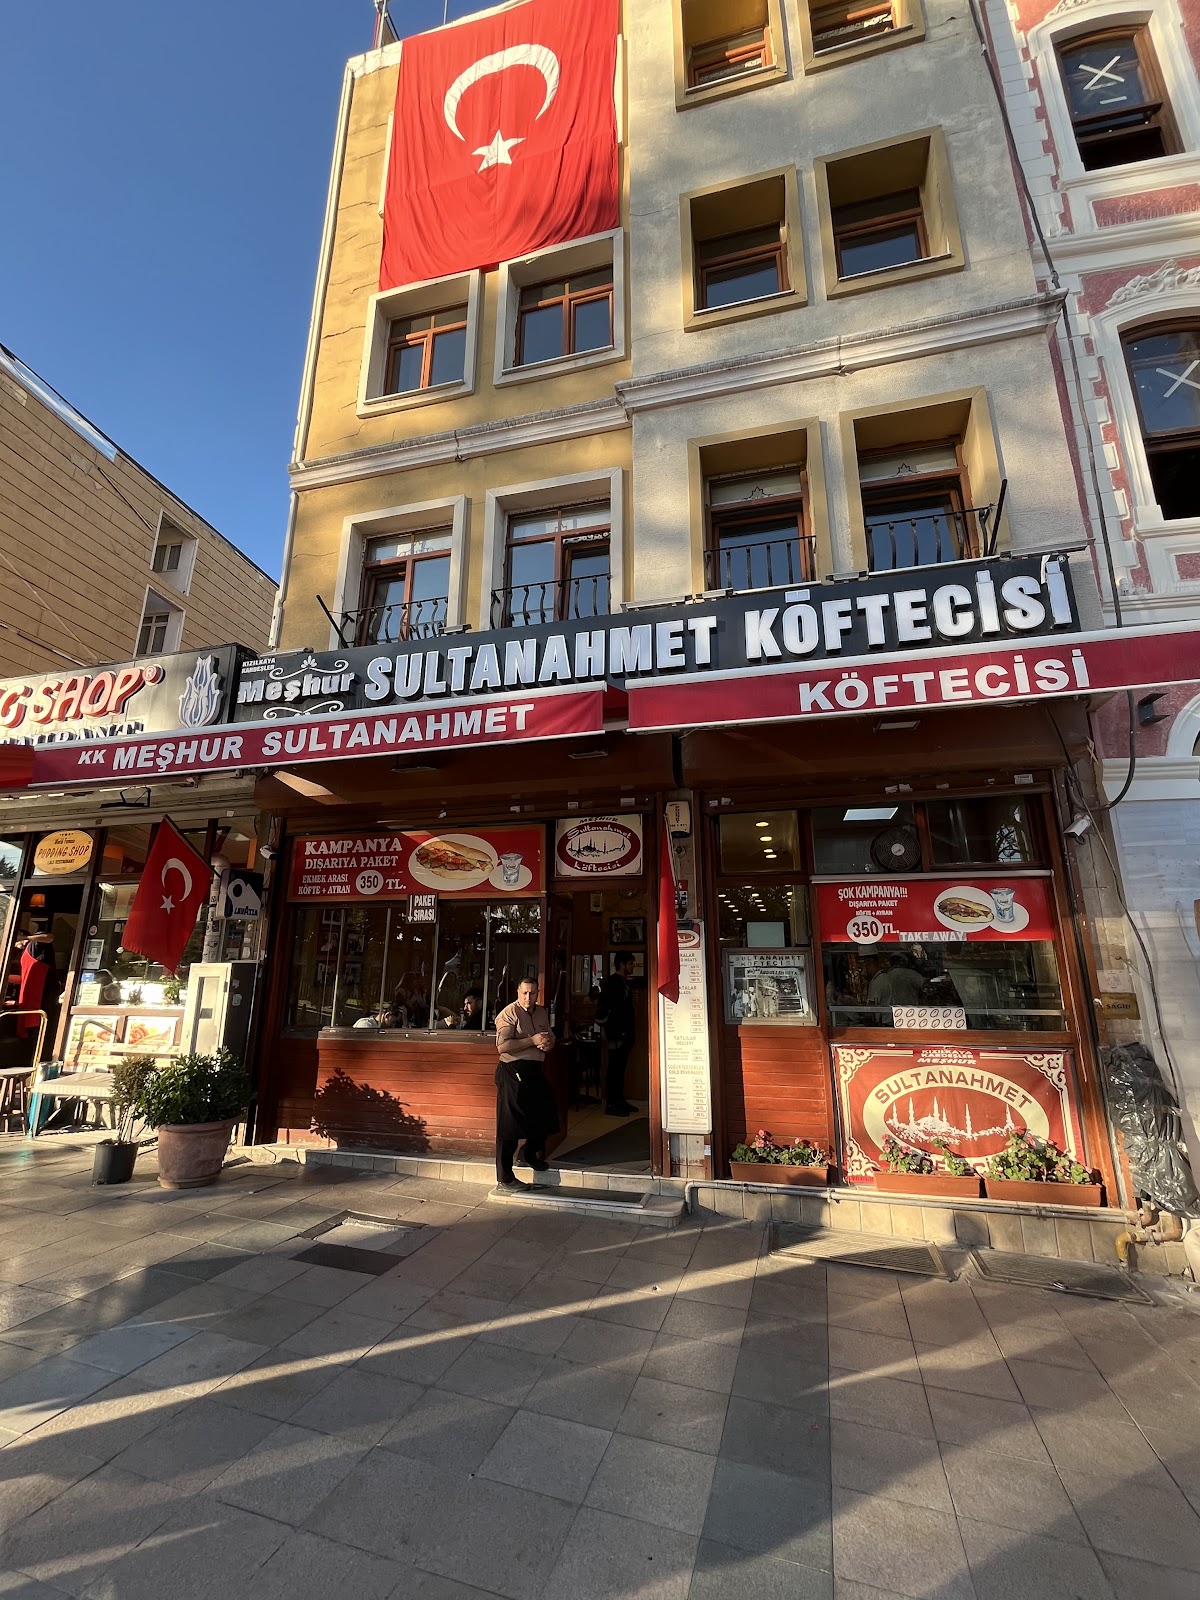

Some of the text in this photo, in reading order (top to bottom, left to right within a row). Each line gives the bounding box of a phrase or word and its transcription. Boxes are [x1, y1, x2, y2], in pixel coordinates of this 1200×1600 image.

[365, 560, 1072, 701] SULTANAHMET KÖFTECİSİ
[236, 671, 355, 704] Meşhur
[799, 649, 1090, 712] KÖFTECİSİ
[78, 703, 535, 772] KK MEŞHUR SULTANAHMET
[37, 845, 90, 859] PUDDING SHOP
[304, 837, 403, 855] KAMPANYA
[304, 855, 399, 871] DIŞARIYA PAKET
[302, 873, 349, 884] EKMEK ARASI
[360, 874, 407, 890] 350 TL.
[298, 884, 321, 895] KÖFTE
[327, 884, 351, 894] AYRAN
[838, 886, 855, 901] ŞOK
[413, 895, 436, 907] PAKET
[848, 899, 899, 909] DIŞARIYA PAKET
[413, 908, 436, 922] SIRASI
[852, 920, 900, 939] 350 TL.
[900, 931, 964, 942] TAKE AWAY
[734, 954, 801, 962] SULTANAHMET
[916, 1057, 977, 1065] MEŞHUR
[874, 1069, 1033, 1109] SULTANAHMET
